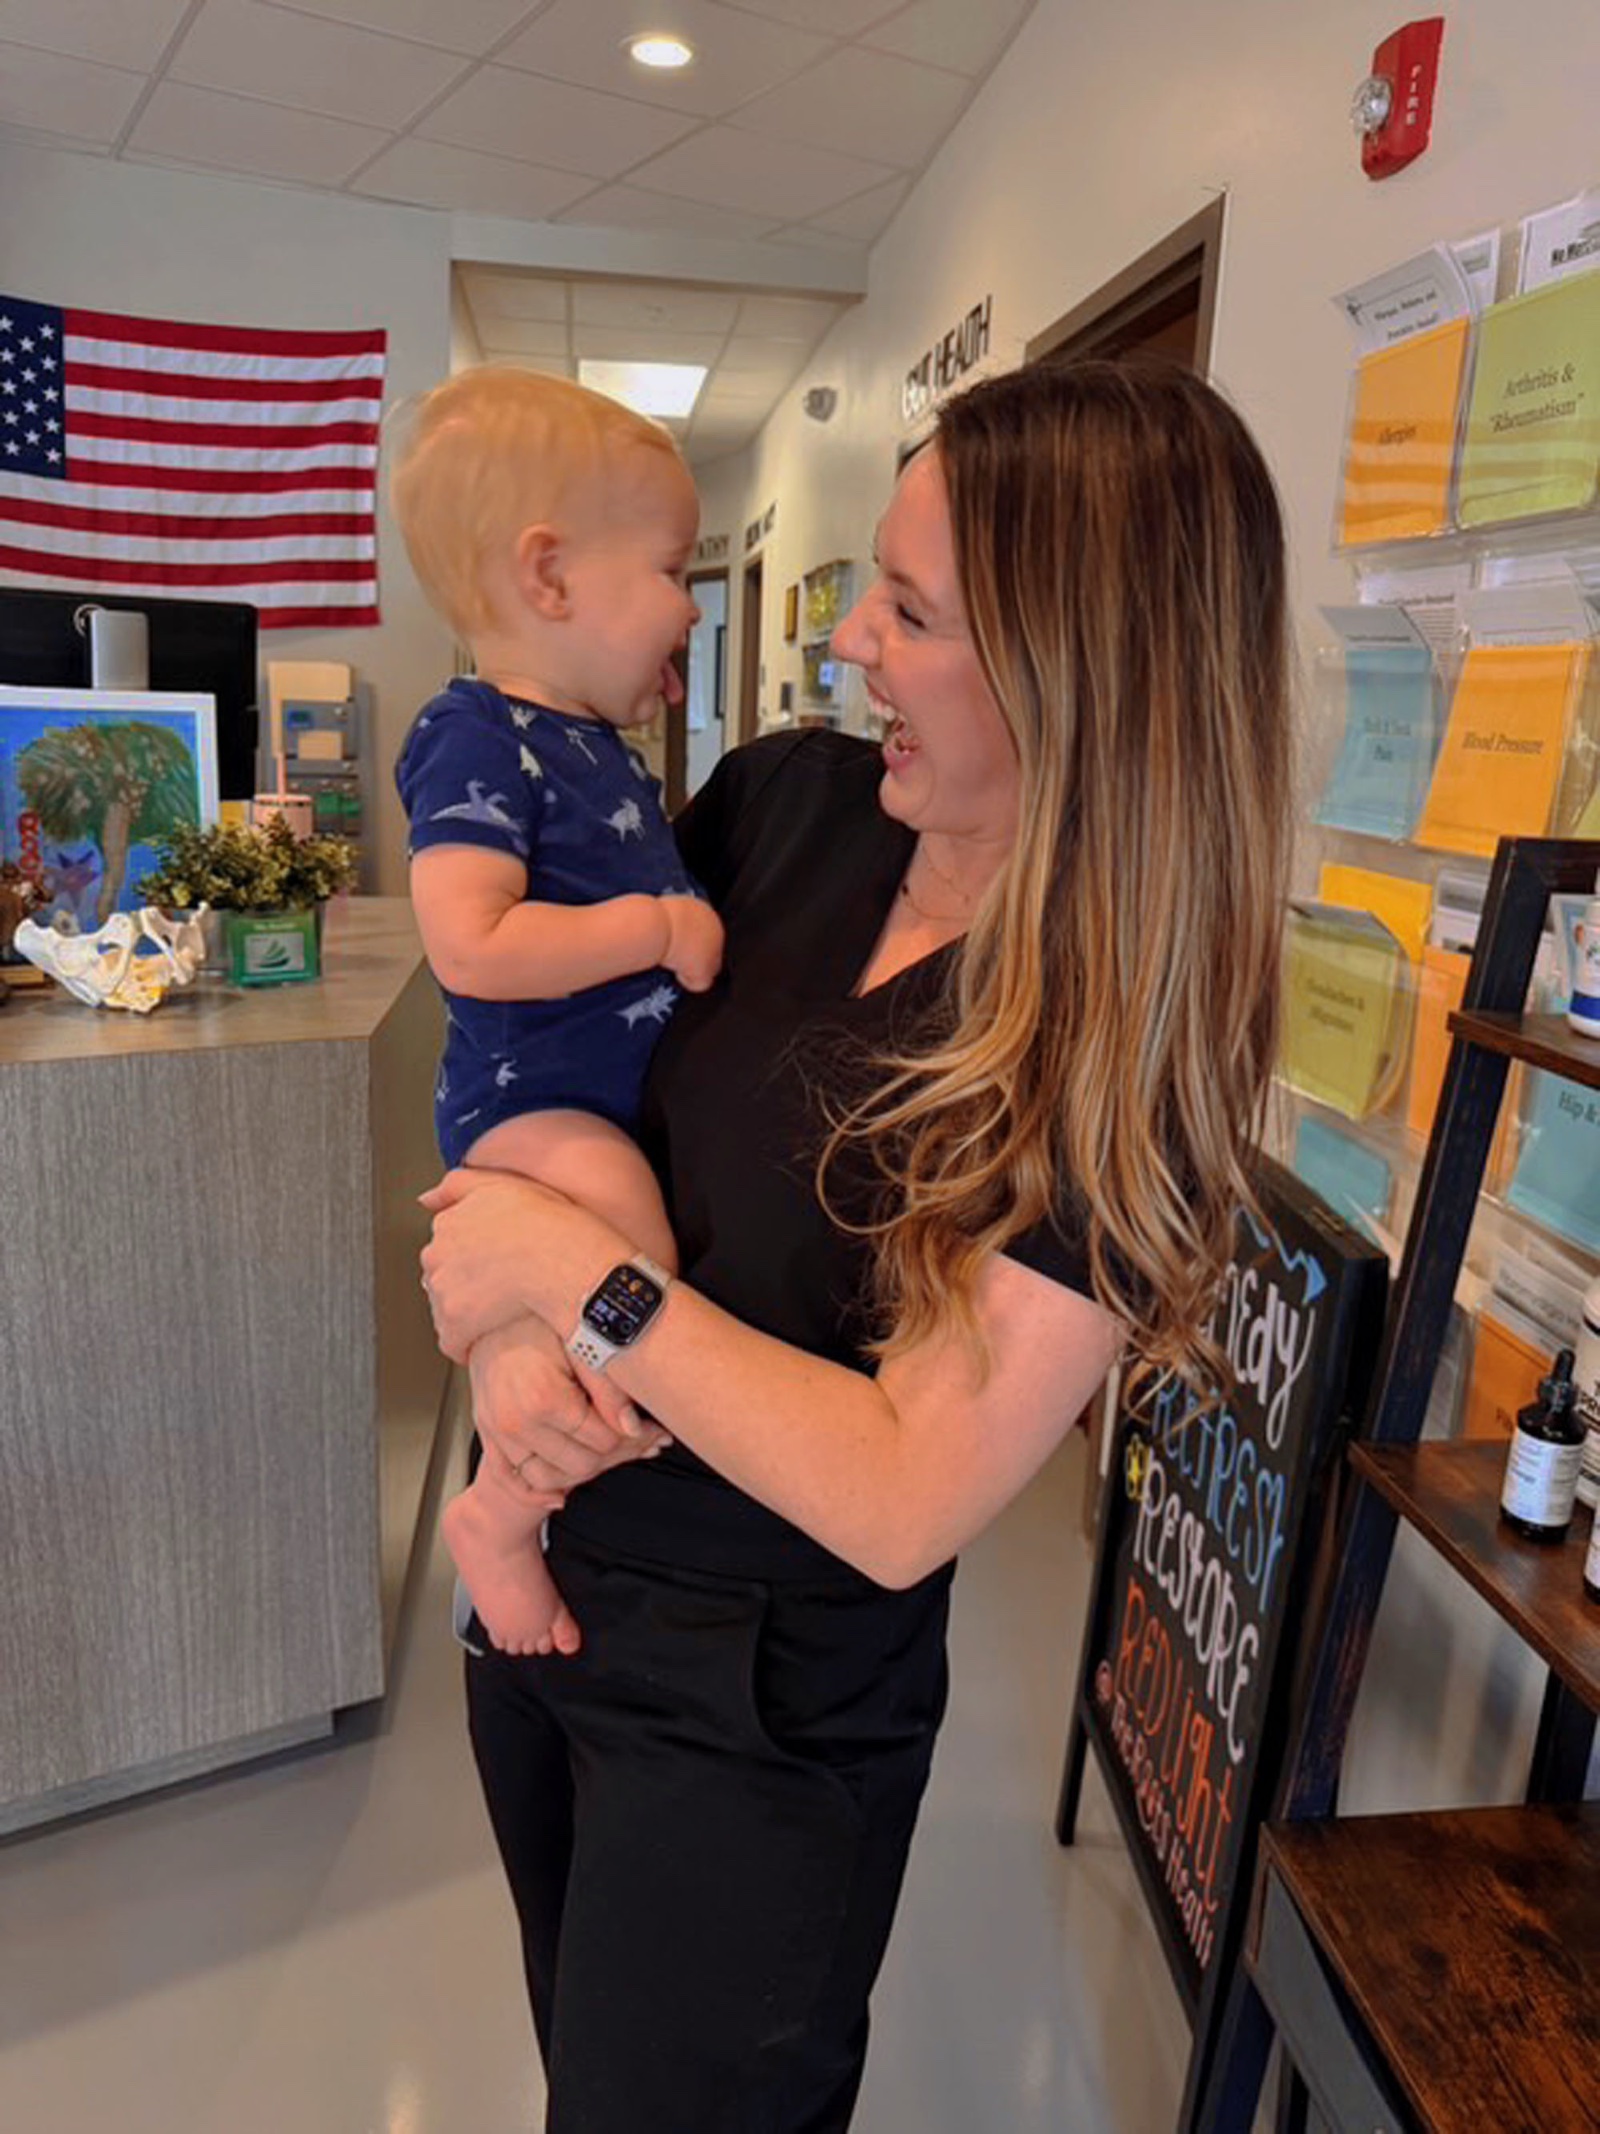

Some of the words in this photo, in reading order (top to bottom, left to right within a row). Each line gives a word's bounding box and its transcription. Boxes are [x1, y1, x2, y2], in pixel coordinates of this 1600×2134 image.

[1406, 64, 1421, 126] FIRE
[934, 294, 992, 398] HEALTH
[1503, 366, 1560, 399] Arthritis
[1561, 361, 1576, 383] &
[1558, 1090, 1585, 1122] Hip
[1113, 1575, 1171, 1737] RED
